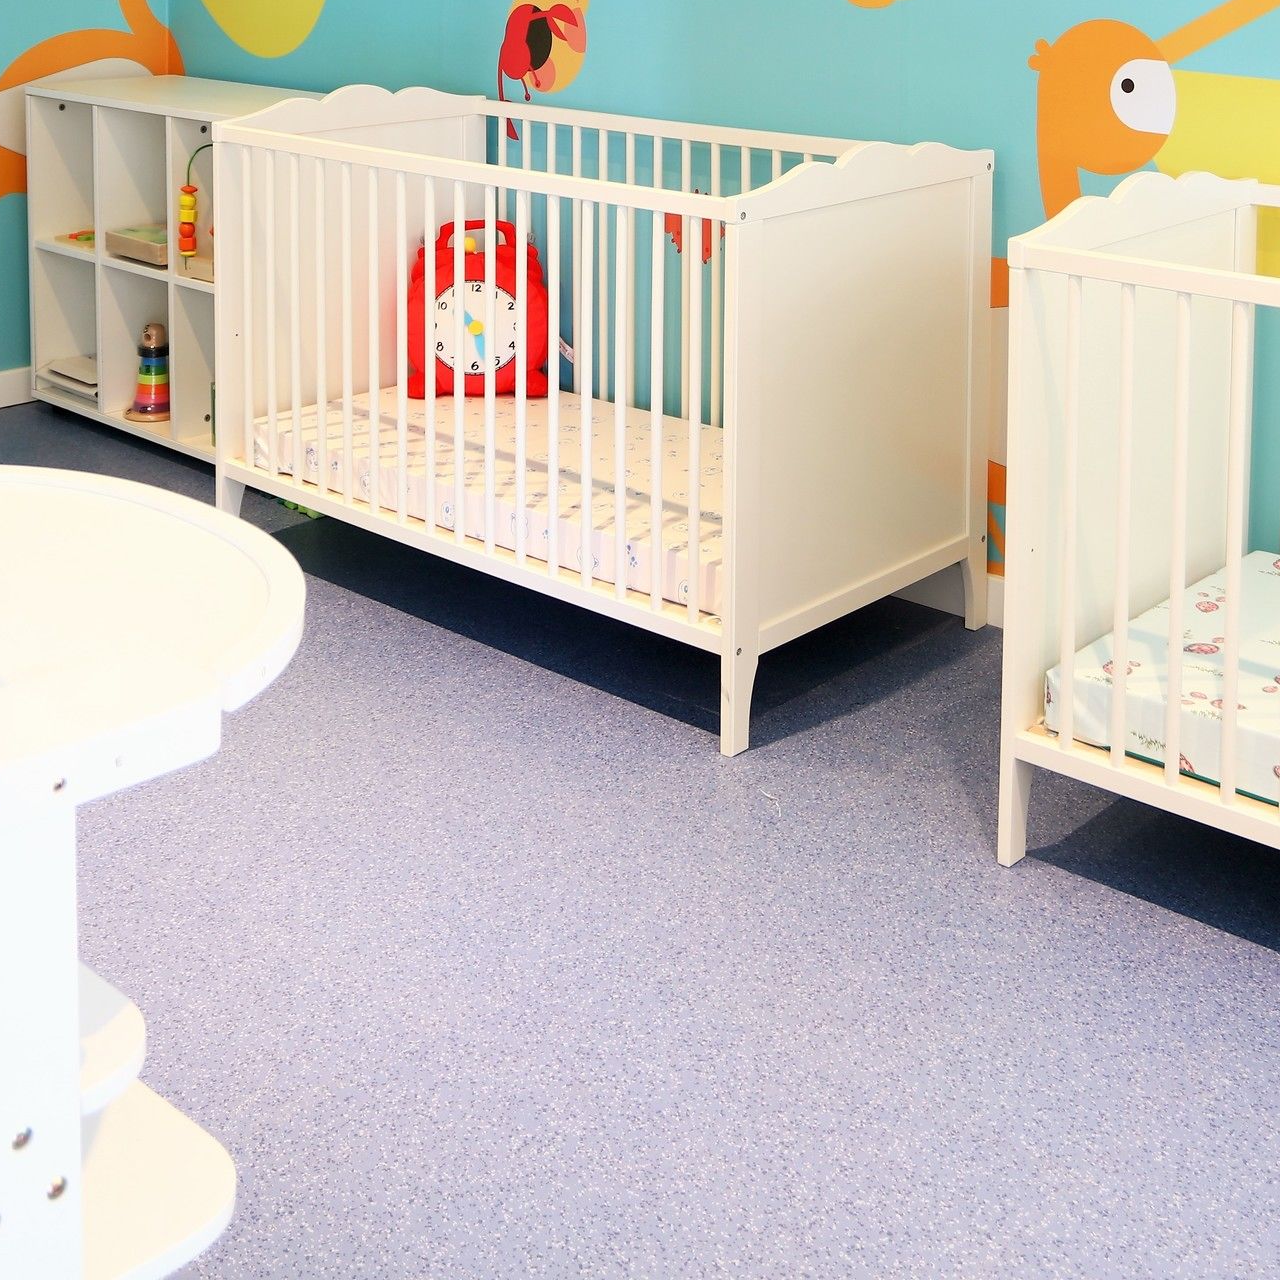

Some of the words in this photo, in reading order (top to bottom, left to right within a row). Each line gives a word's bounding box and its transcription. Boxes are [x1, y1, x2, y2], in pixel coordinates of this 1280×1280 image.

[471, 284, 482, 293] 12
[438, 302, 448, 310] 10
[507, 302, 515, 310] 2
[436, 341, 444, 352] 8
[508, 341, 516, 350] 4
[471, 361, 479, 371] 6
